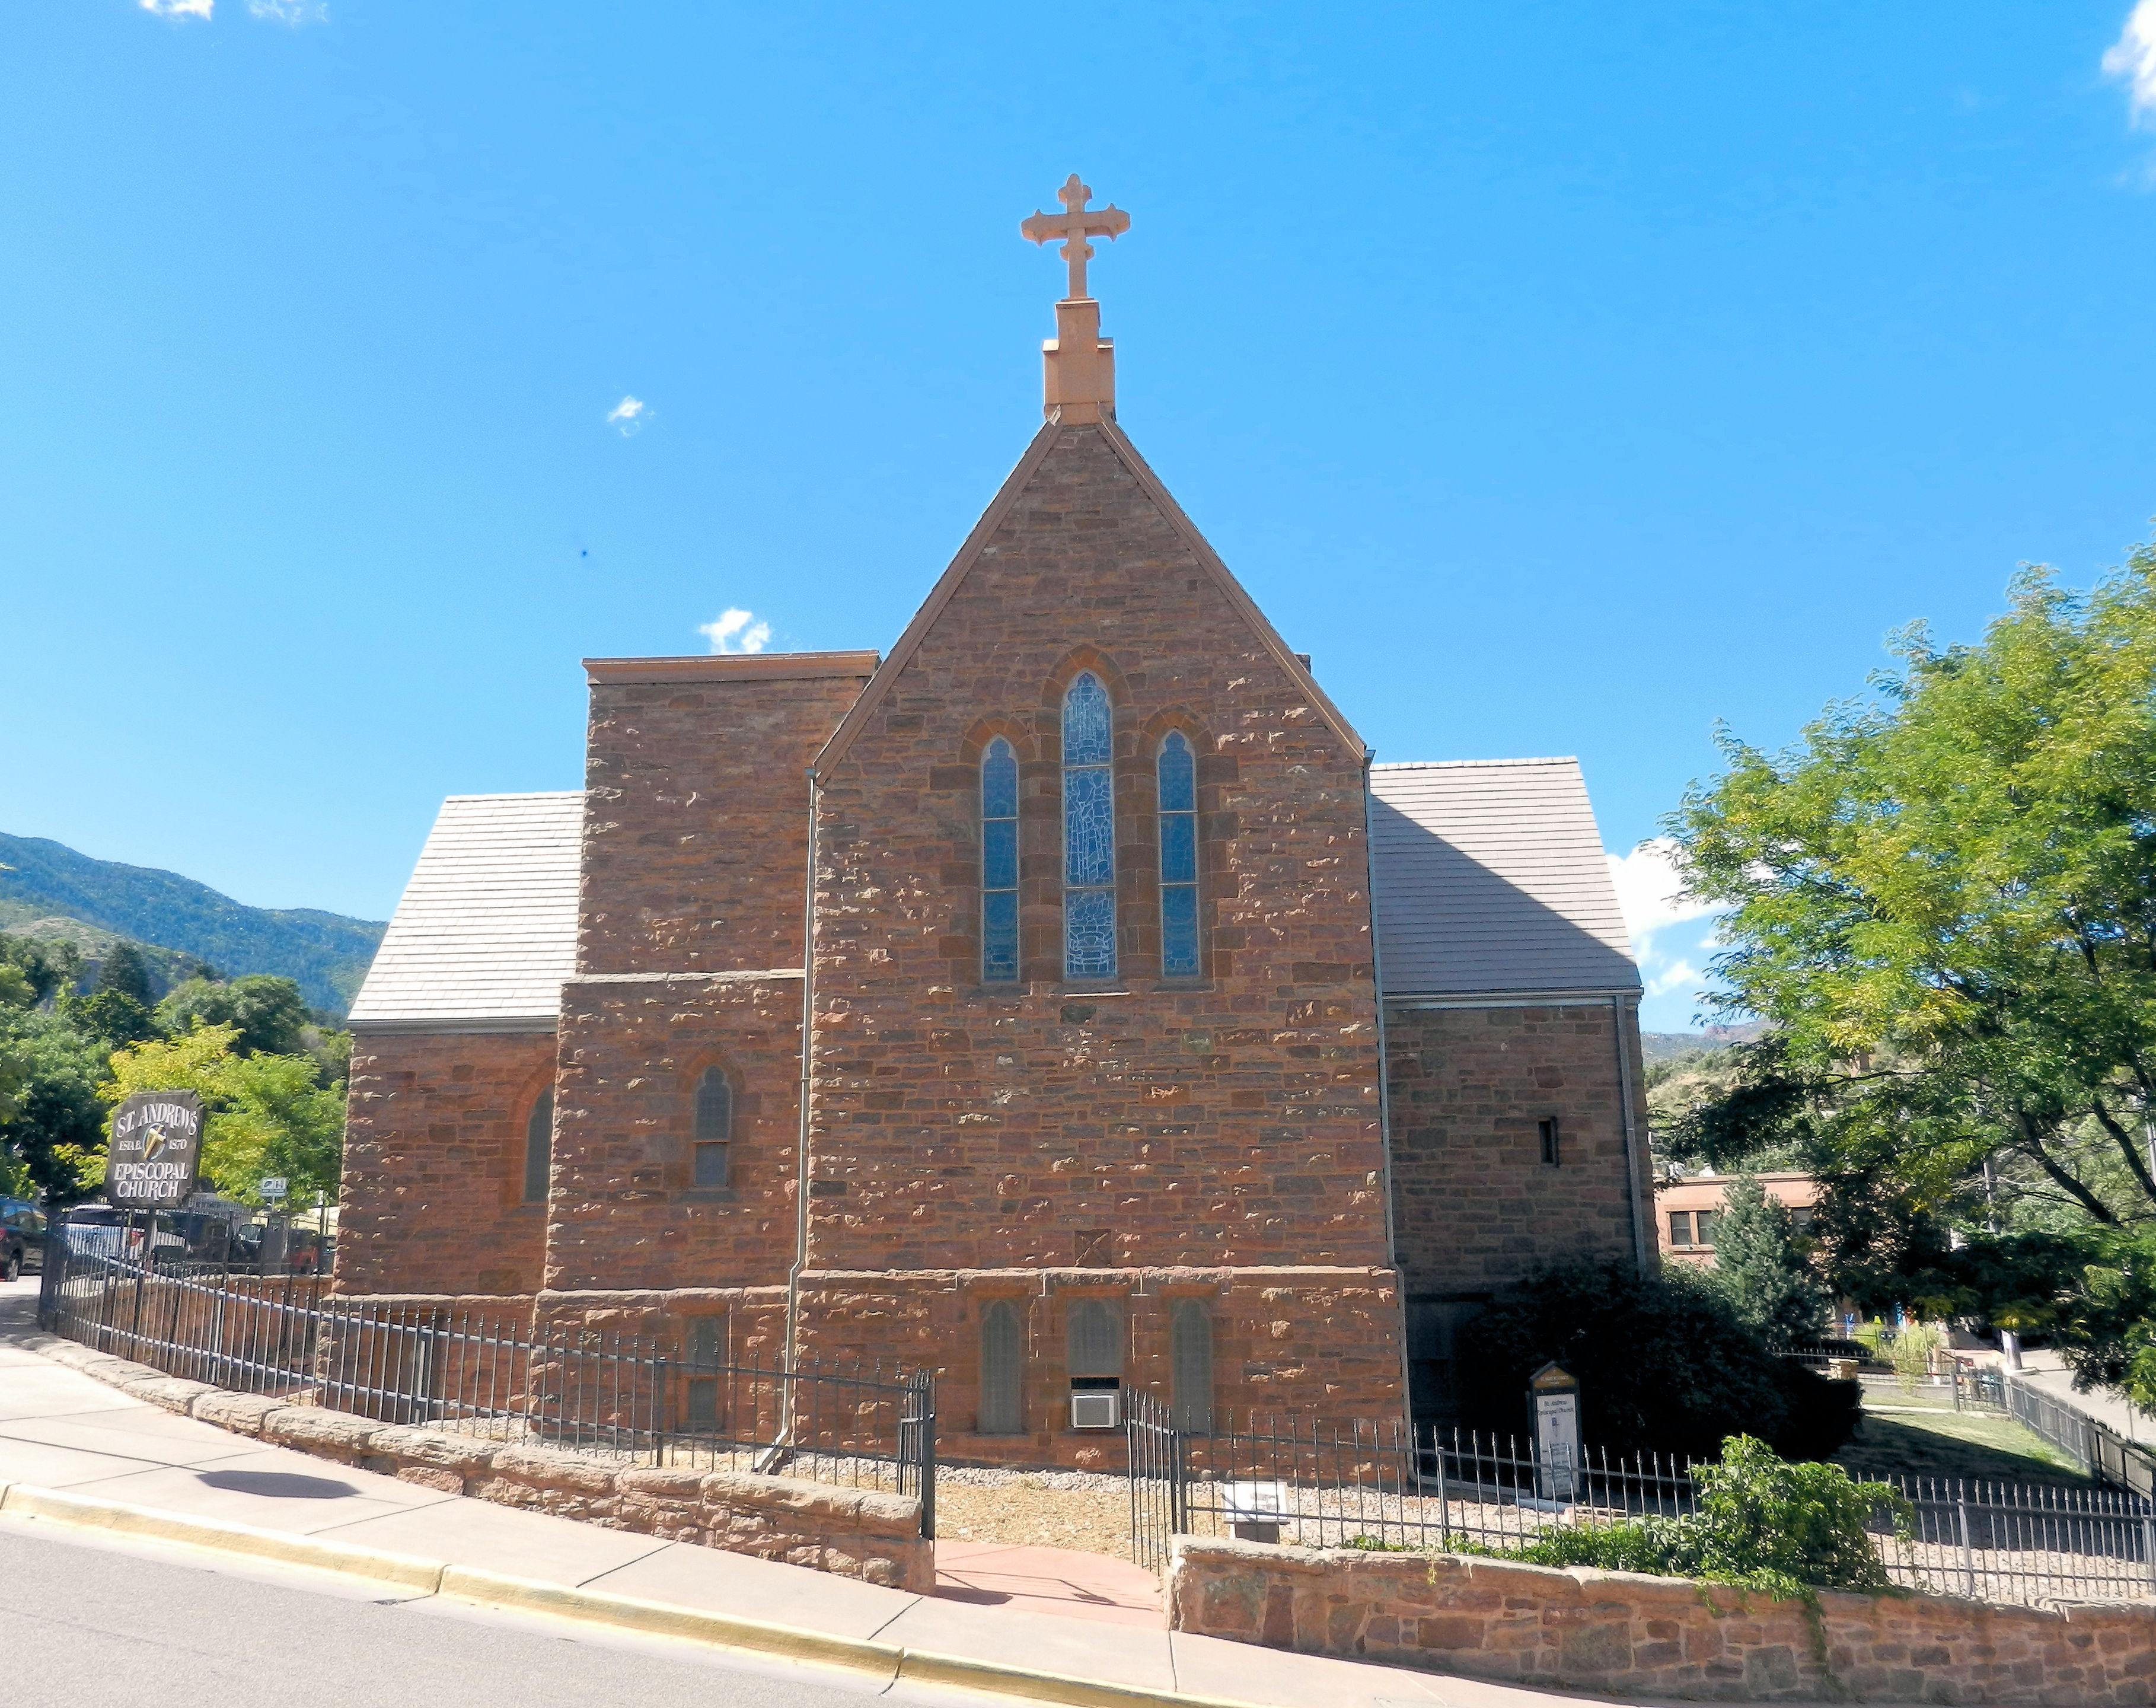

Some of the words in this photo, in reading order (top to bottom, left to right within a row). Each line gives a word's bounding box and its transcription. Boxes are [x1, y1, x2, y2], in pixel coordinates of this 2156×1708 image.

[138, 1103, 197, 1135] ANDREW'S
[114, 1162, 189, 1180] EPISCOPAL
[117, 1181, 178, 1201] CHURCH
